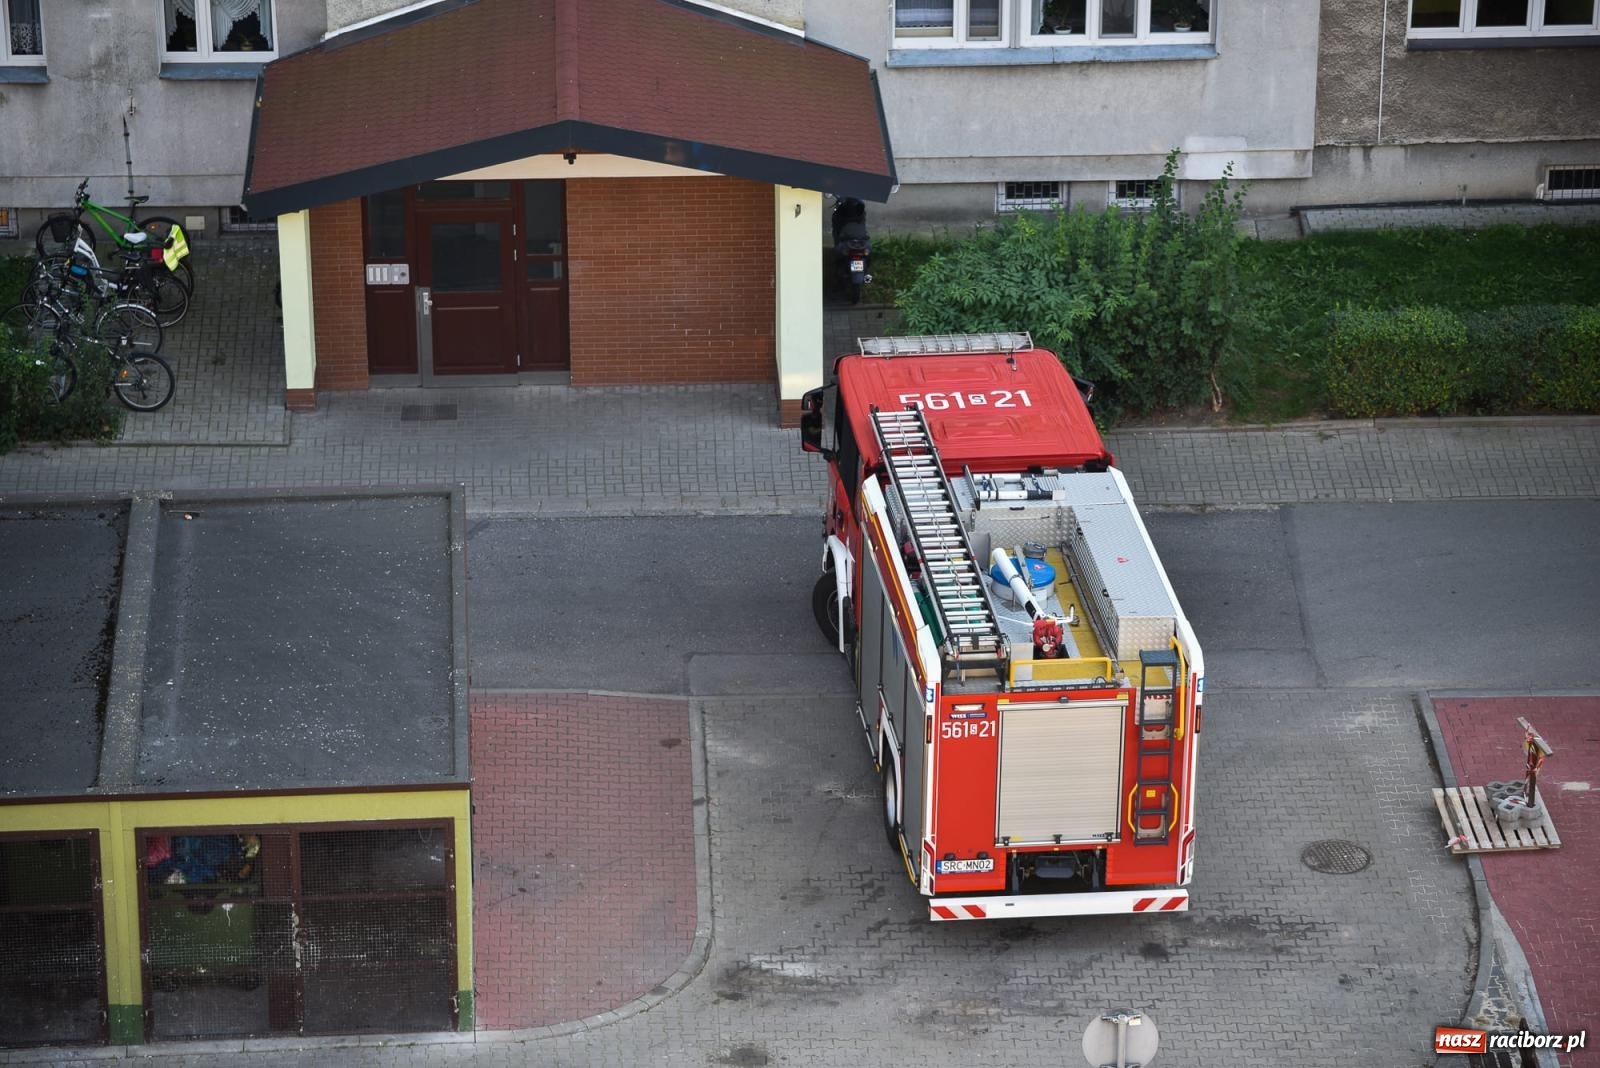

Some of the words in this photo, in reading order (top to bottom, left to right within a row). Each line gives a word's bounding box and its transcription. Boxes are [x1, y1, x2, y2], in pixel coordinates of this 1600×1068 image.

[990, 389, 1032, 408] 21
[941, 721, 969, 739] 561
[979, 720, 996, 738] 21
[943, 861, 962, 871] SRC
